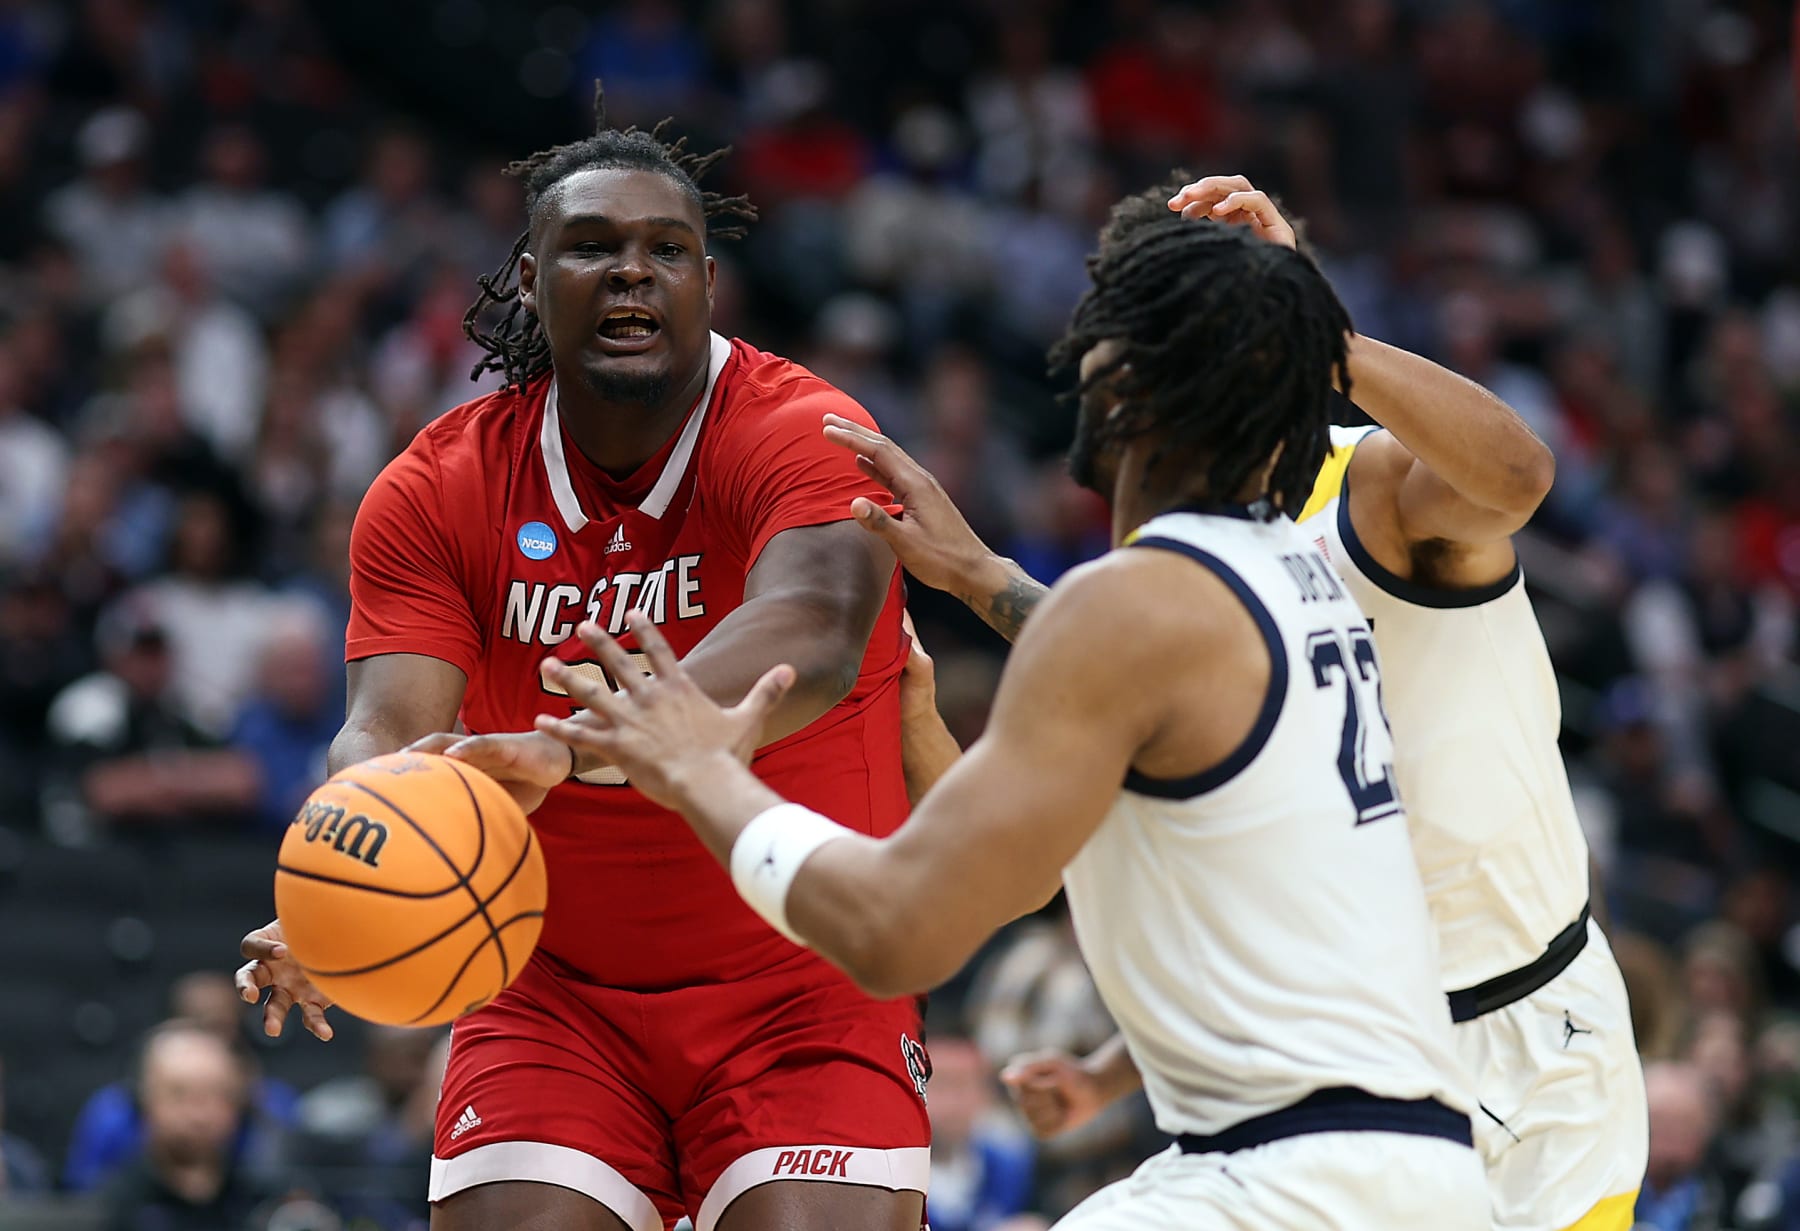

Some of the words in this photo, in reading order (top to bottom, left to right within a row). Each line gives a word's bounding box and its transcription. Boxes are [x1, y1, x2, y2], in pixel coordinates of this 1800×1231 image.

[521, 536, 555, 553] NCAA
[450, 1117, 482, 1140] adidas
[772, 1149, 854, 1178] PACK
